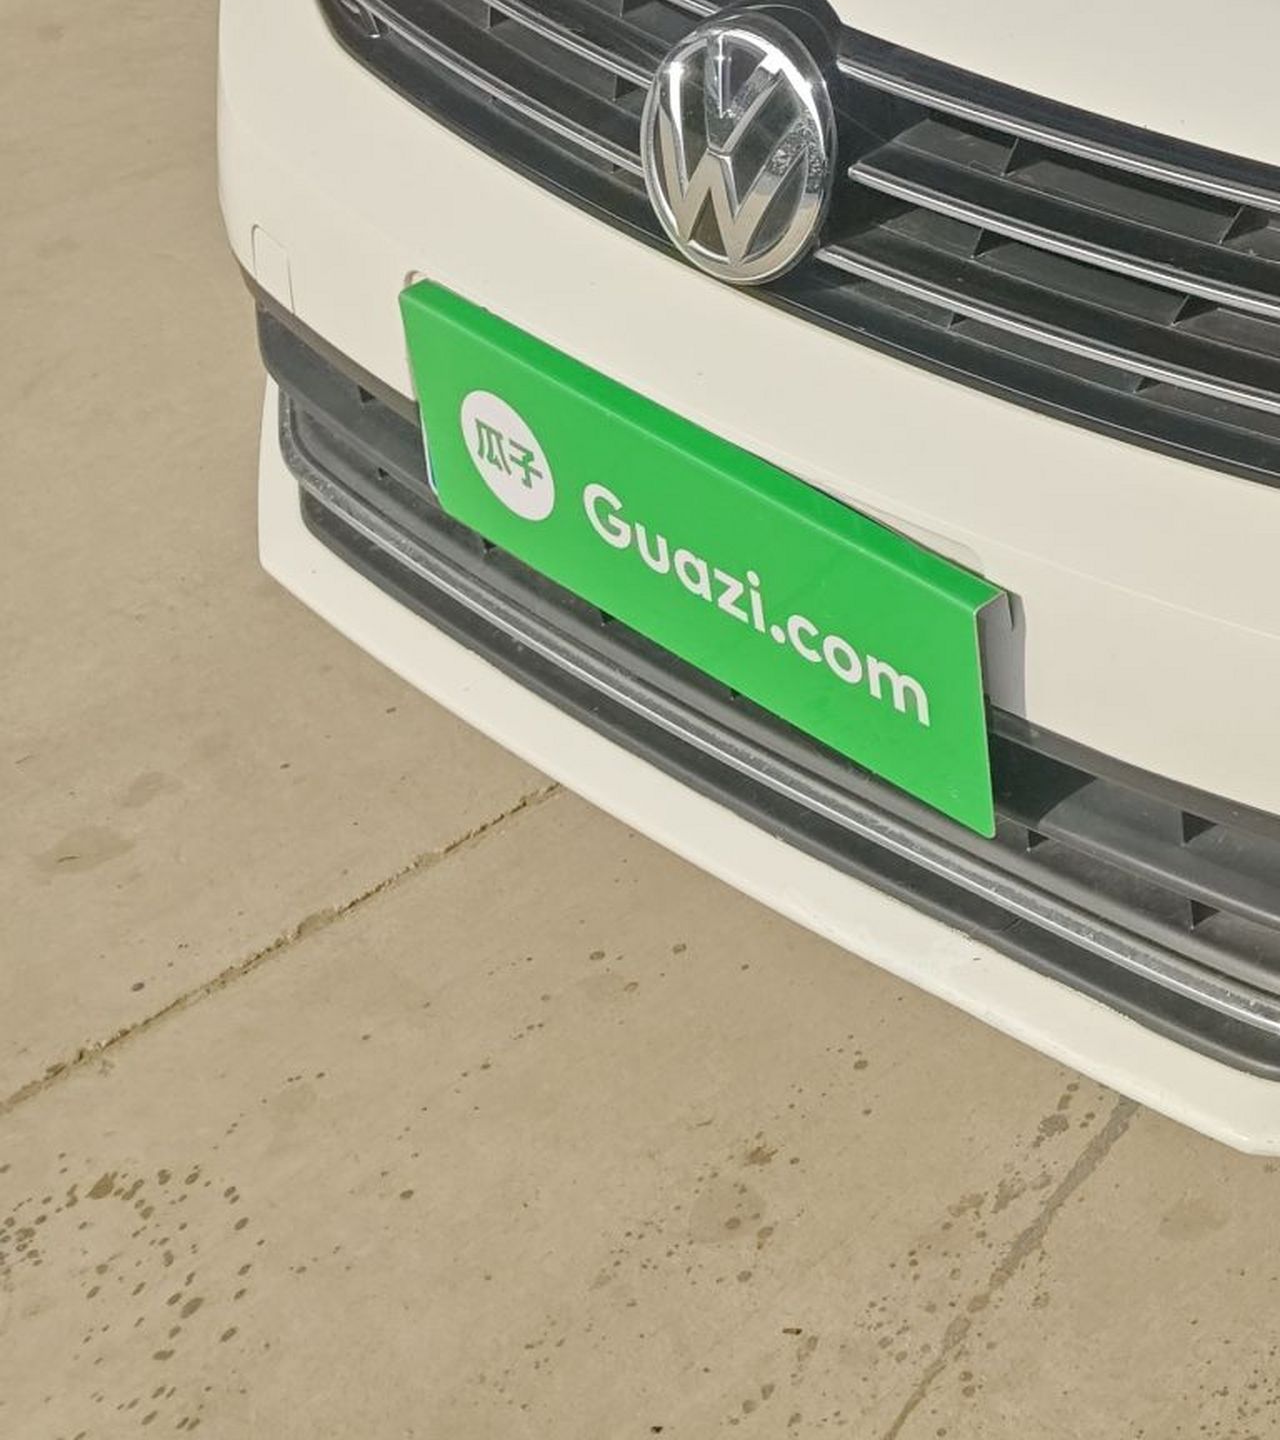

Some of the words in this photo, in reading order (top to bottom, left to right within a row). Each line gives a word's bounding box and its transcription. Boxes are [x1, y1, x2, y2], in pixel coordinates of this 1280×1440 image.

[652, 32, 816, 268] VW
[474, 417, 544, 490] 瓜子
[582, 483, 932, 727] Guazi.com
